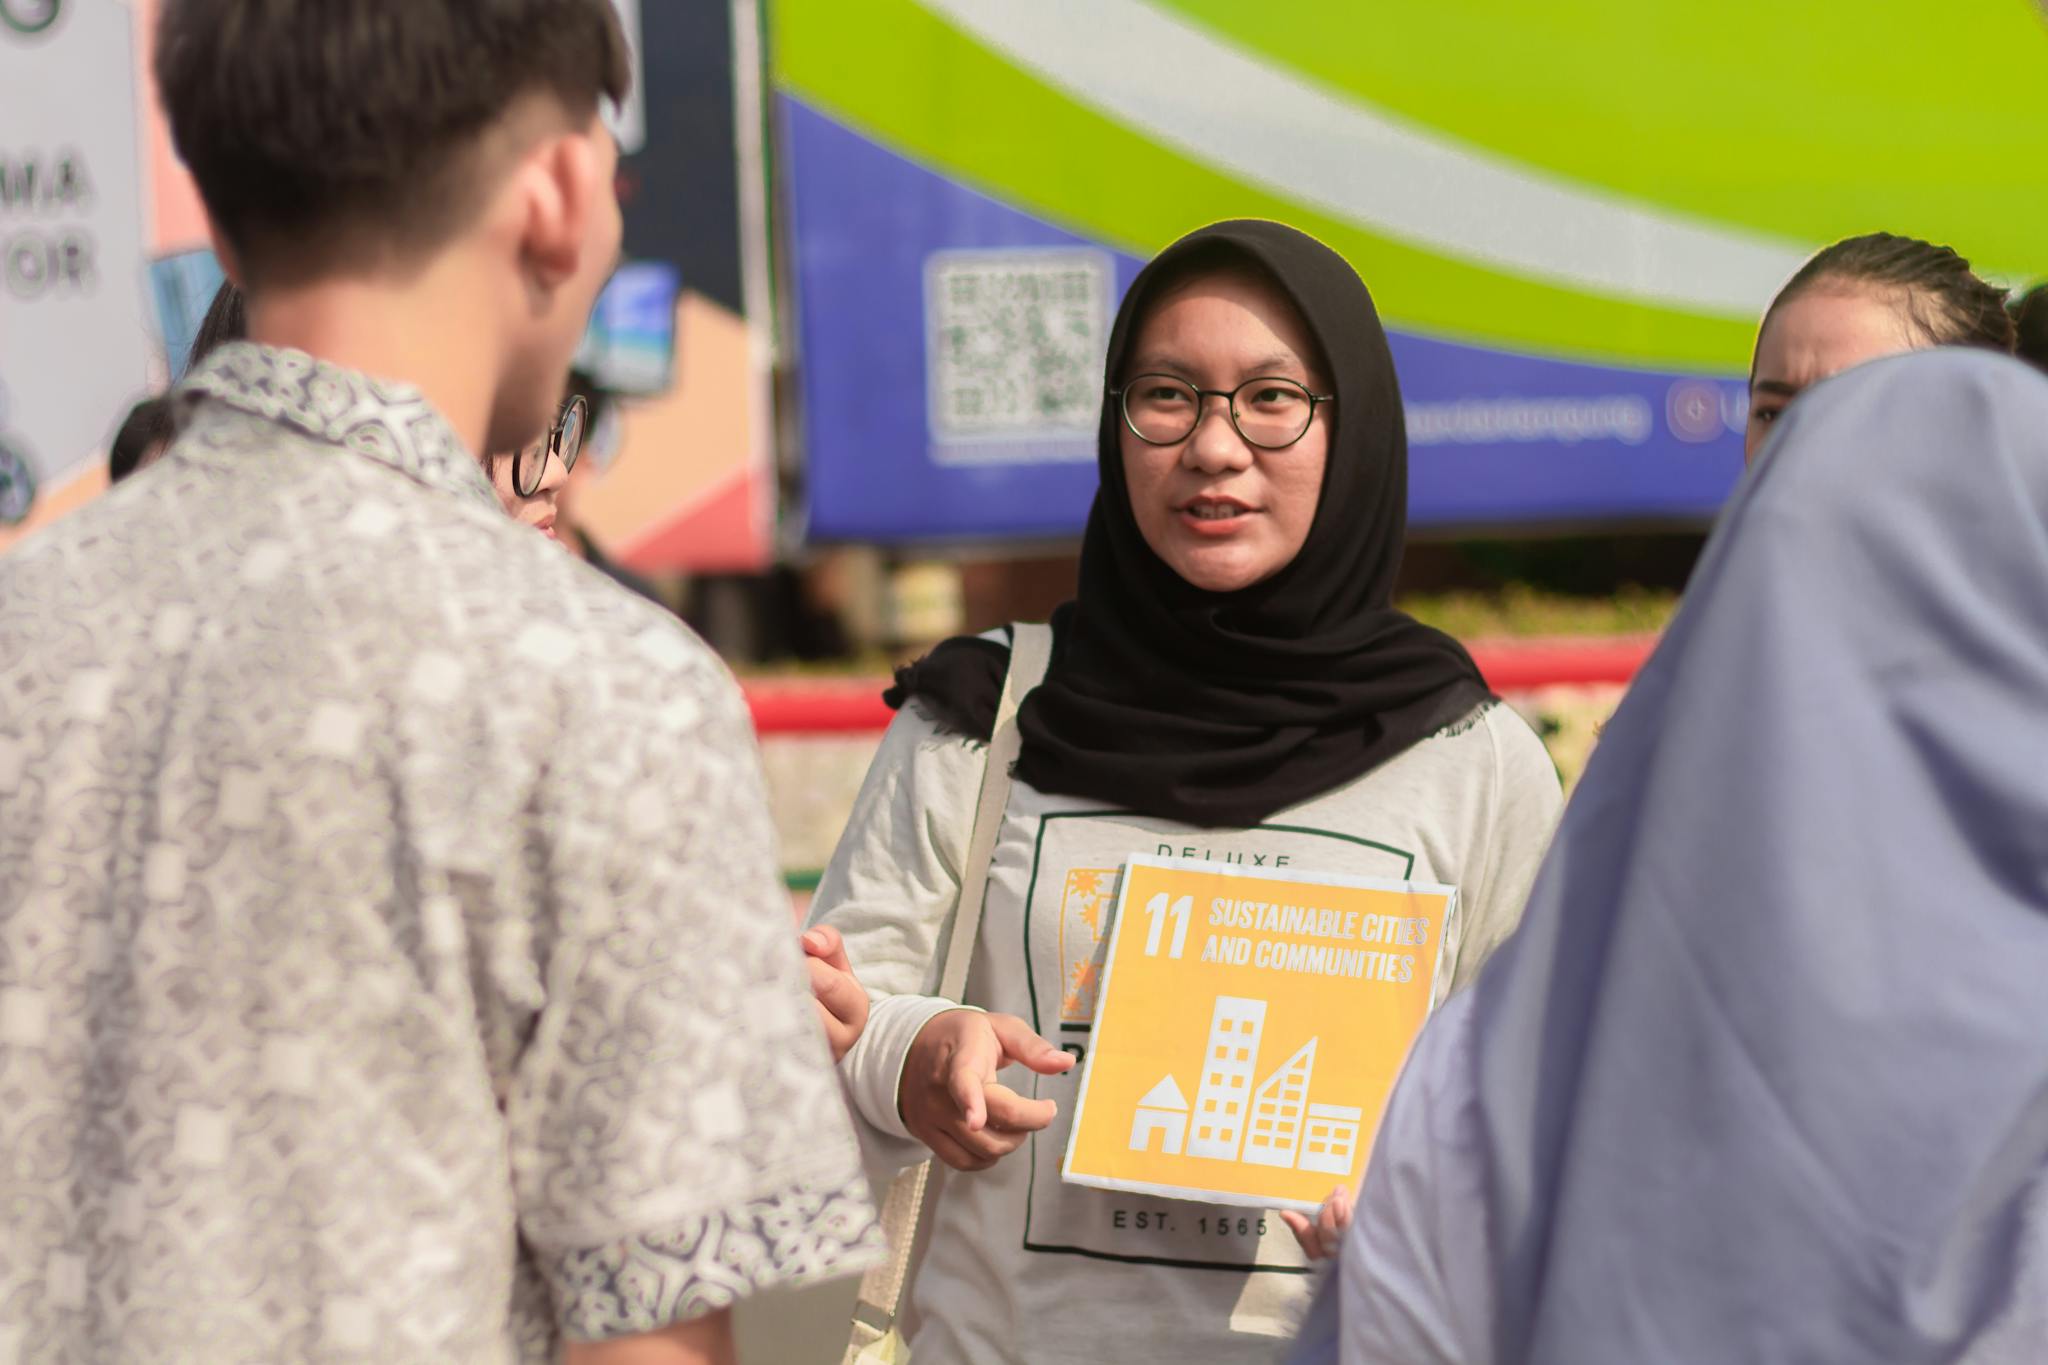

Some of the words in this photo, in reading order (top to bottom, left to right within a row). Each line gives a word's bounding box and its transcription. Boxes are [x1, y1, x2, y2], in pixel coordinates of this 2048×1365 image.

[1157, 843, 1290, 868] DELUXE
[1144, 891, 1194, 960] 11
[1208, 897, 1359, 940] SUSTAINABLE
[1361, 913, 1430, 946] CITIES
[1200, 934, 1252, 966] AND
[1254, 939, 1415, 983] COMMUNITIES
[1113, 1210, 1176, 1231] EST.
[1198, 1217, 1268, 1236] 1565
